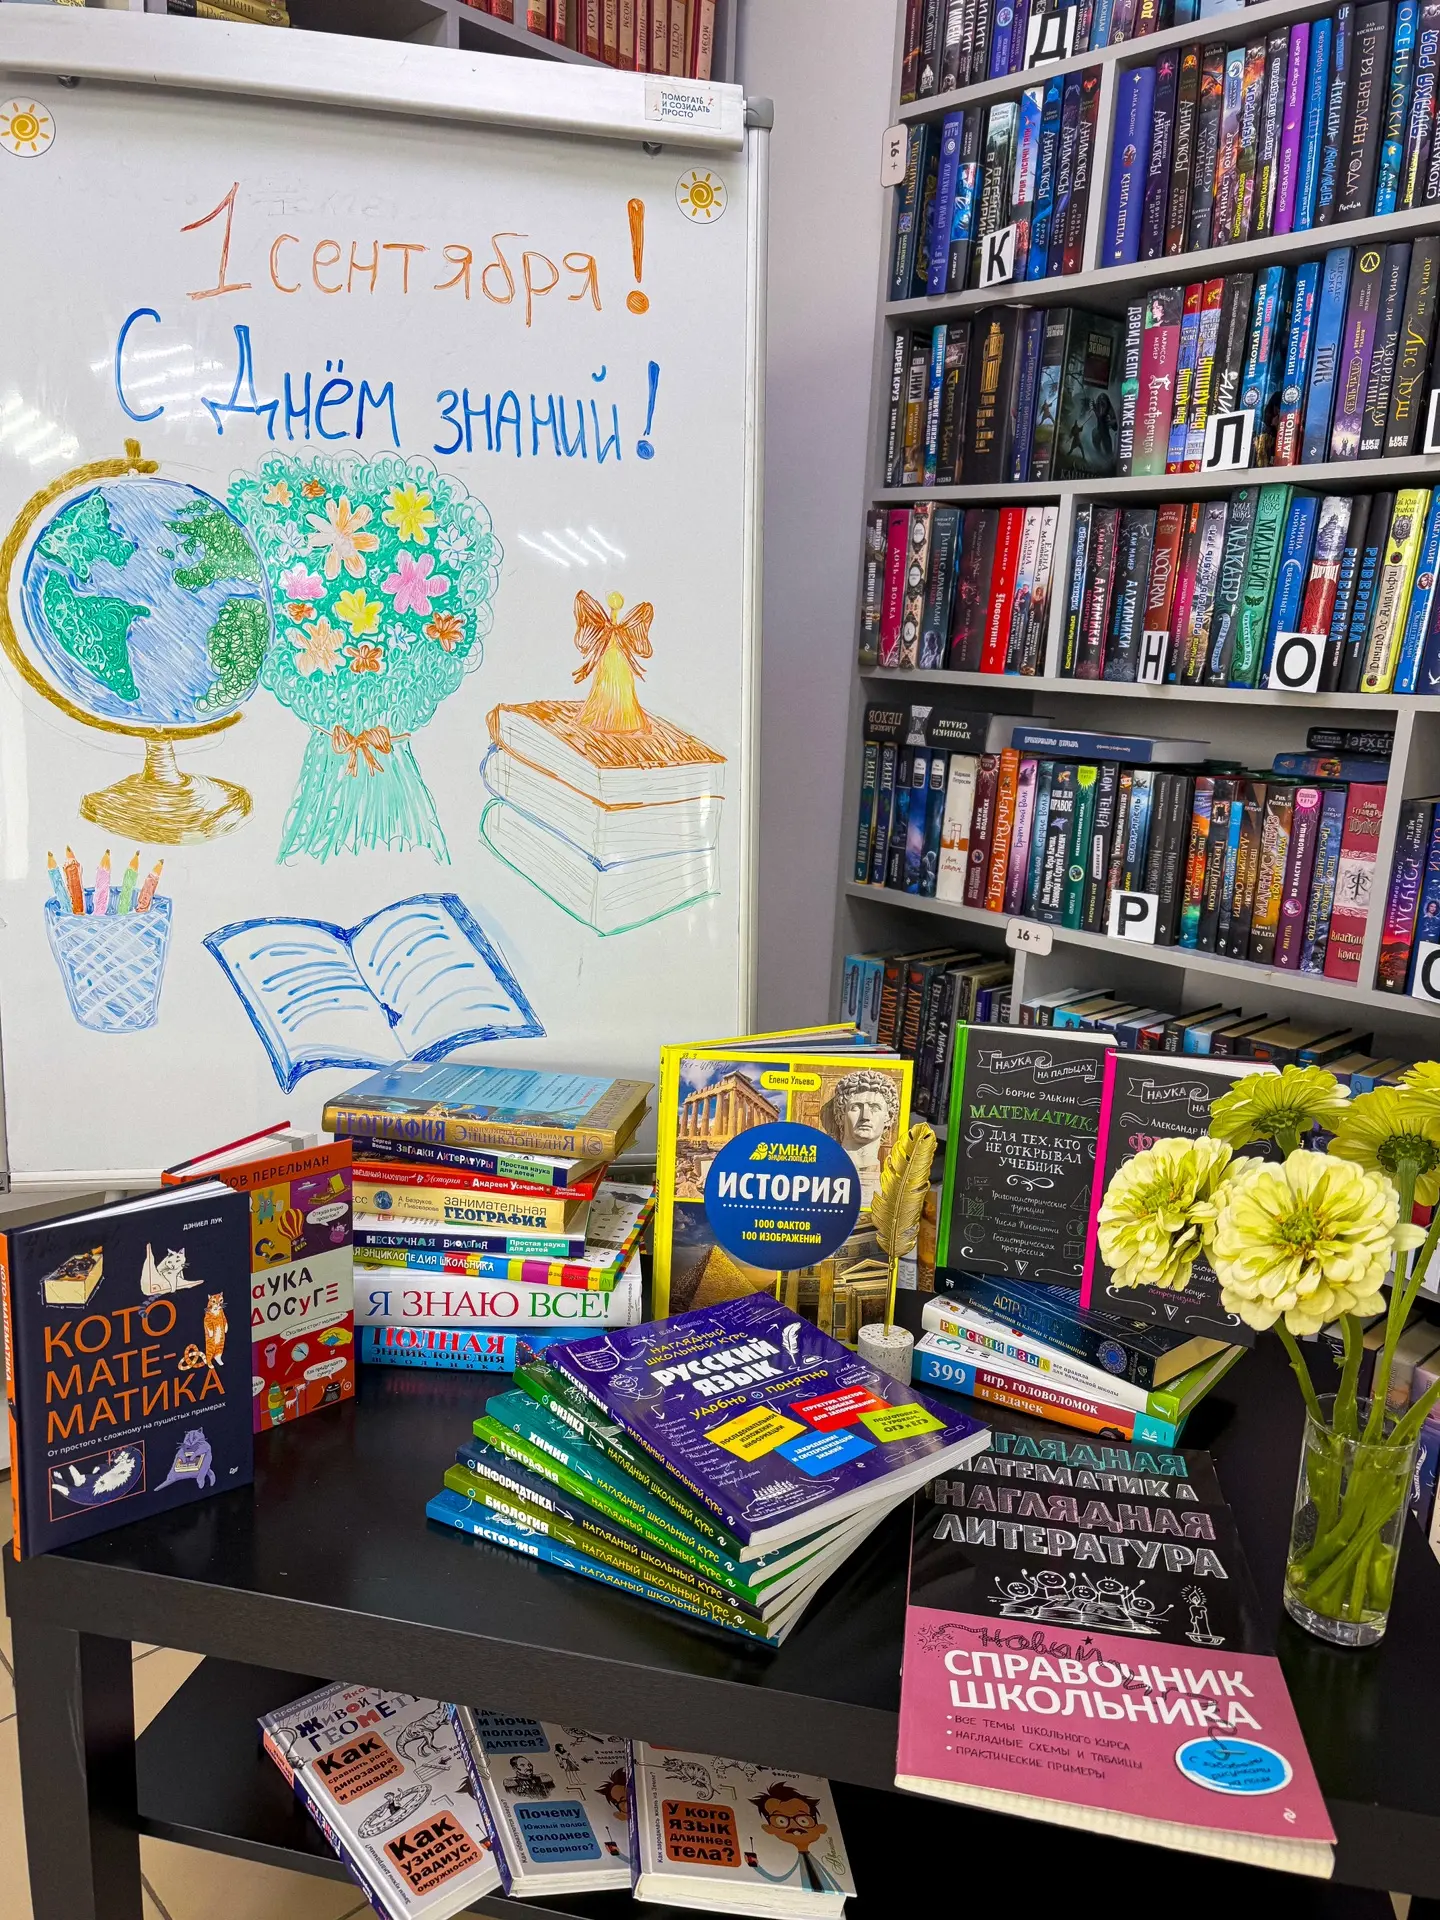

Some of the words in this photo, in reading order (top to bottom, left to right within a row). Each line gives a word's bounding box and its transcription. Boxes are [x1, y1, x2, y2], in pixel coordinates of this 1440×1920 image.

[672, 23, 680, 59] ОСТЕН
[701, 25, 709, 54] МОЭМ
[1395, 8, 1412, 74] ОСЕНЬ
[1360, 36, 1375, 77] БУРЯ
[661, 92, 703, 104] ПОМОГАТЬ
[661, 108, 693, 118] ПРОСТО
[669, 102, 710, 113] СОЗИДАТЬ
[1353, 80, 1371, 144] ВРЕМЁН
[1388, 84, 1405, 138] ЛОКИ
[891, 140, 900, 157] 16
[180, 182, 252, 300] 1
[987, 231, 1010, 283] К
[1126, 307, 1142, 346] ДЭВИД
[1248, 330, 1261, 378] НИКОЛАЙ
[1255, 284, 1267, 328] ХМУРЫЙ
[1287, 327, 1300, 376] НИКОЛАЙ
[1294, 279, 1306, 324] ХМУРЫЙ
[893, 336, 904, 374] АНДРЕЙ
[1124, 348, 1140, 378] КЕПП
[116, 308, 163, 422] С
[202, 324, 401, 448] Днём
[892, 376, 901, 401] КРУЗ
[910, 369, 923, 400] КИНГ
[1122, 394, 1136, 424] НИЖЕ
[1120, 425, 1133, 459] НУЛЯ
[1207, 415, 1245, 467] Л
[1277, 421, 1285, 452] МИХАИЛ
[1282, 412, 1295, 459] ЛАНЦОВ
[1149, 548, 1172, 610] NOCTURNA
[1329, 547, 1358, 642] РИВЕРДЕЙЛ
[1349, 547, 1379, 643] РИВЕРДЕЙЛ
[1088, 577, 1106, 646] АЛХИМИКИ
[1118, 580, 1138, 648] АЛХИМИКИ
[1142, 634, 1163, 681] Н
[1276, 637, 1317, 688] О
[869, 710, 902, 726] ПЕХОВ
[932, 728, 971, 739] ХРОНИКИ
[938, 720, 968, 730] СИАЛЫ
[1293, 860, 1301, 887] ВЛАСТИ
[1297, 823, 1307, 859] ЧУДОВИЩА
[1117, 895, 1149, 937] Р
[1017, 928, 1030, 941] 16
[995, 1056, 1032, 1070] НАУКА
[1037, 1071, 1048, 1079] НА
[1051, 1064, 1092, 1077] ПАЛЬЦАХ
[768, 1074, 789, 1085] Елена
[791, 1076, 815, 1087] Ульева
[1005, 1087, 1035, 1098] БОРИС
[1039, 1092, 1075, 1104] ЭЛЬКИН
[1146, 1087, 1187, 1100] НАУКА
[336, 1111, 446, 1142] ГЕОГРАФИЯ
[989, 1130, 1016, 1142] ДЛЯ
[1021, 1134, 1051, 1147] ТЕХ,
[1054, 1138, 1080, 1150] КТО
[1150, 1118, 1198, 1135] АЛЕКСАНДР
[768, 1143, 817, 1157] УМНАЯ
[985, 1142, 1002, 1153] НЕ
[1005, 1145, 1082, 1164] ОТКРЫВАЛ
[999, 1156, 1064, 1175] УЧЕБНИК
[253, 1155, 329, 1182] ПЕРЕЛЬМАН
[500, 1160, 529, 1172] Простая
[530, 1165, 551, 1175] наука
[514, 1169, 535, 1178] детей
[718, 1172, 851, 1204] ИСТОРИЯ
[183, 1219, 209, 1230] ДЭНИЕЛ
[210, 1216, 223, 1225] ЛУК
[444, 1197, 547, 1216] занимательная
[444, 1207, 546, 1228] ГЕОГРАФИЯ
[742, 1231, 757, 1240] 100
[759, 1232, 822, 1244] ИЗОБРАЖЕНИЙ
[754, 1219, 775, 1228] 1000
[777, 1221, 810, 1230] ФАКТОВ
[363, 1247, 437, 1266] ЭНЦИКЛОПЕДИЯ
[440, 1256, 495, 1272] ШКОЛЬНИКА
[365, 1291, 392, 1317] Я
[402, 1290, 520, 1318] ЗНАЮ
[528, 1292, 610, 1319] ВСЕ!
[43, 1300, 177, 1363] КОТО
[371, 1326, 506, 1355] ПОЛНАЯ
[650, 1328, 726, 1354] НАГЛЯДНЫЙ
[940, 1320, 1005, 1353] РУССКИЙ
[1007, 1345, 1050, 1371] ЯЗЫК
[371, 1347, 505, 1363] ЭНЦИКЛОПЕДИЯ
[371, 1357, 505, 1371] ШКОЛЬНИКА
[644, 1341, 716, 1366] ШКОЛЬНЫЙ
[717, 1332, 749, 1345] КУРС
[650, 1337, 780, 1387] РУССКИЙ
[45, 1344, 177, 1404] МАТЕ-
[560, 1366, 588, 1395] РУССКИЙ
[588, 1391, 608, 1413] ЯЗЫК
[692, 1360, 784, 1397] ЯЗЫК
[928, 1361, 966, 1385] 399
[47, 1368, 226, 1443] МАТИКА
[689, 1395, 746, 1420] УДОБНО
[765, 1370, 829, 1394] ПОНЯТНО
[983, 1373, 1008, 1390] игр,
[1012, 1382, 1098, 1415] головоломок
[60, 1438, 96, 1454] простого
[103, 1425, 142, 1441] сложному
[153, 1412, 189, 1427] пушистых
[191, 1401, 226, 1417] примерах
[550, 1400, 585, 1436] ФИЗИКА
[500, 1441, 559, 1483] ГЕОГРАФИЯ
[528, 1432, 569, 1465] ХИМИЯ
[476, 1462, 554, 1512] ИНФОРМАТИКА
[485, 1495, 549, 1534] БИОЛОГИЯ
[933, 1479, 1217, 1541] НАГЛЯДНАЯ
[473, 1524, 538, 1556] ИСТОРИЯ
[932, 1513, 1230, 1579] ЛИТЕРАТУРА
[944, 1650, 1255, 1698] СПРАВОЧНИК
[949, 1679, 1263, 1729] ШКОЛЬНИКА
[955, 1714, 977, 1726] ВСЕ
[982, 1718, 1015, 1731] ТЕМЫ
[1022, 1725, 1091, 1745] ШКОЛЬНОГО
[1094, 1738, 1131, 1751] КУРСА
[316, 1737, 381, 1776] Как
[955, 1730, 1023, 1748] НАГЛЯДНЫЕ
[1029, 1742, 1070, 1756] СХЕМЫ
[1091, 1752, 1143, 1769] ТАБЛИЦЫ
[955, 1746, 1043, 1768] ПРАКТИЧЕСКИЕ
[1047, 1762, 1106, 1779] ПРИМЕРЫ
[519, 1808, 580, 1820] Почему
[667, 1803, 680, 1816] У
[685, 1807, 730, 1821] кого
[388, 1815, 456, 1862] Как
[401, 1831, 465, 1875] узнать
[528, 1832, 590, 1842] холоднее
[531, 1843, 594, 1854] Северного?
[670, 1834, 733, 1846] длиннее
[670, 1845, 735, 1862] тела?
[409, 1843, 472, 1886] радиус
